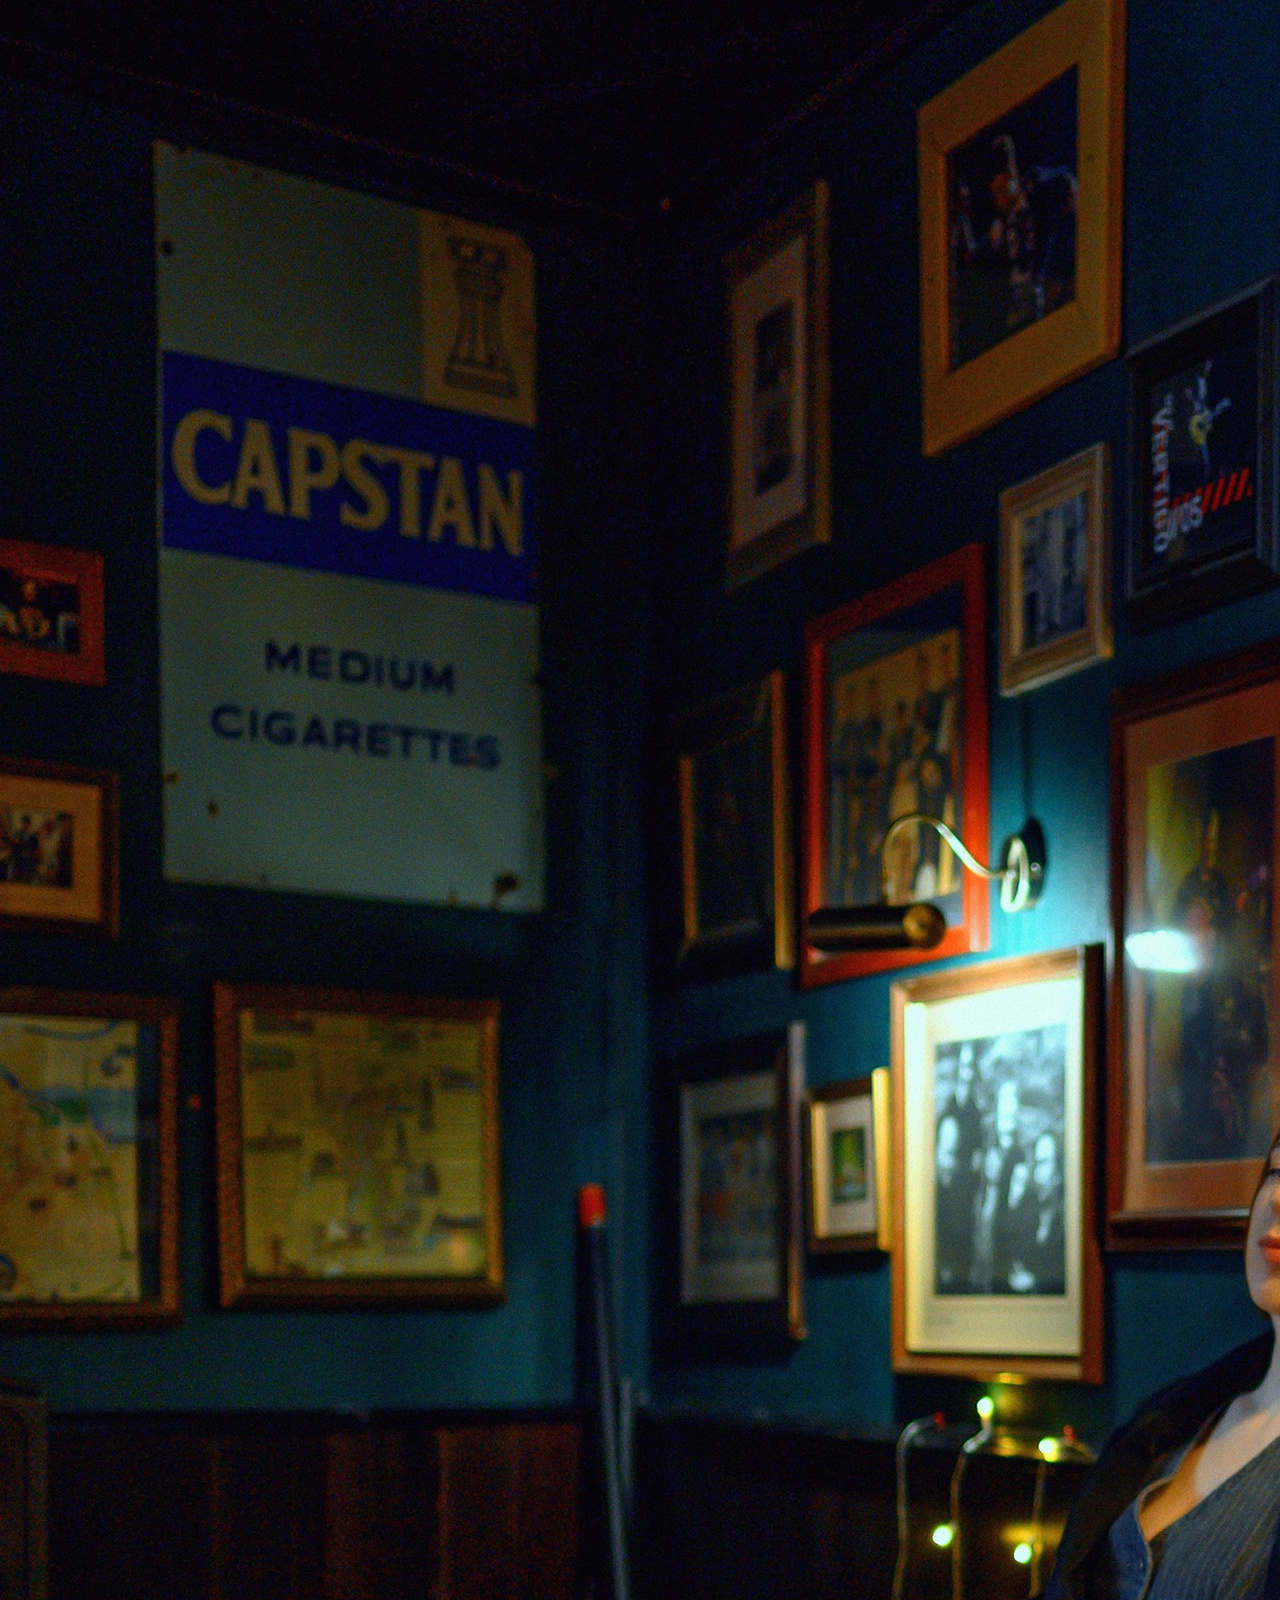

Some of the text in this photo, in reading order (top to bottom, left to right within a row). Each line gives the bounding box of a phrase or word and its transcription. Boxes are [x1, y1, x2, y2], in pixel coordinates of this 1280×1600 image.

[171, 408, 525, 557] CAPSTAN
[264, 639, 456, 697] MEDIUM
[210, 704, 501, 771] CIGARETTES
